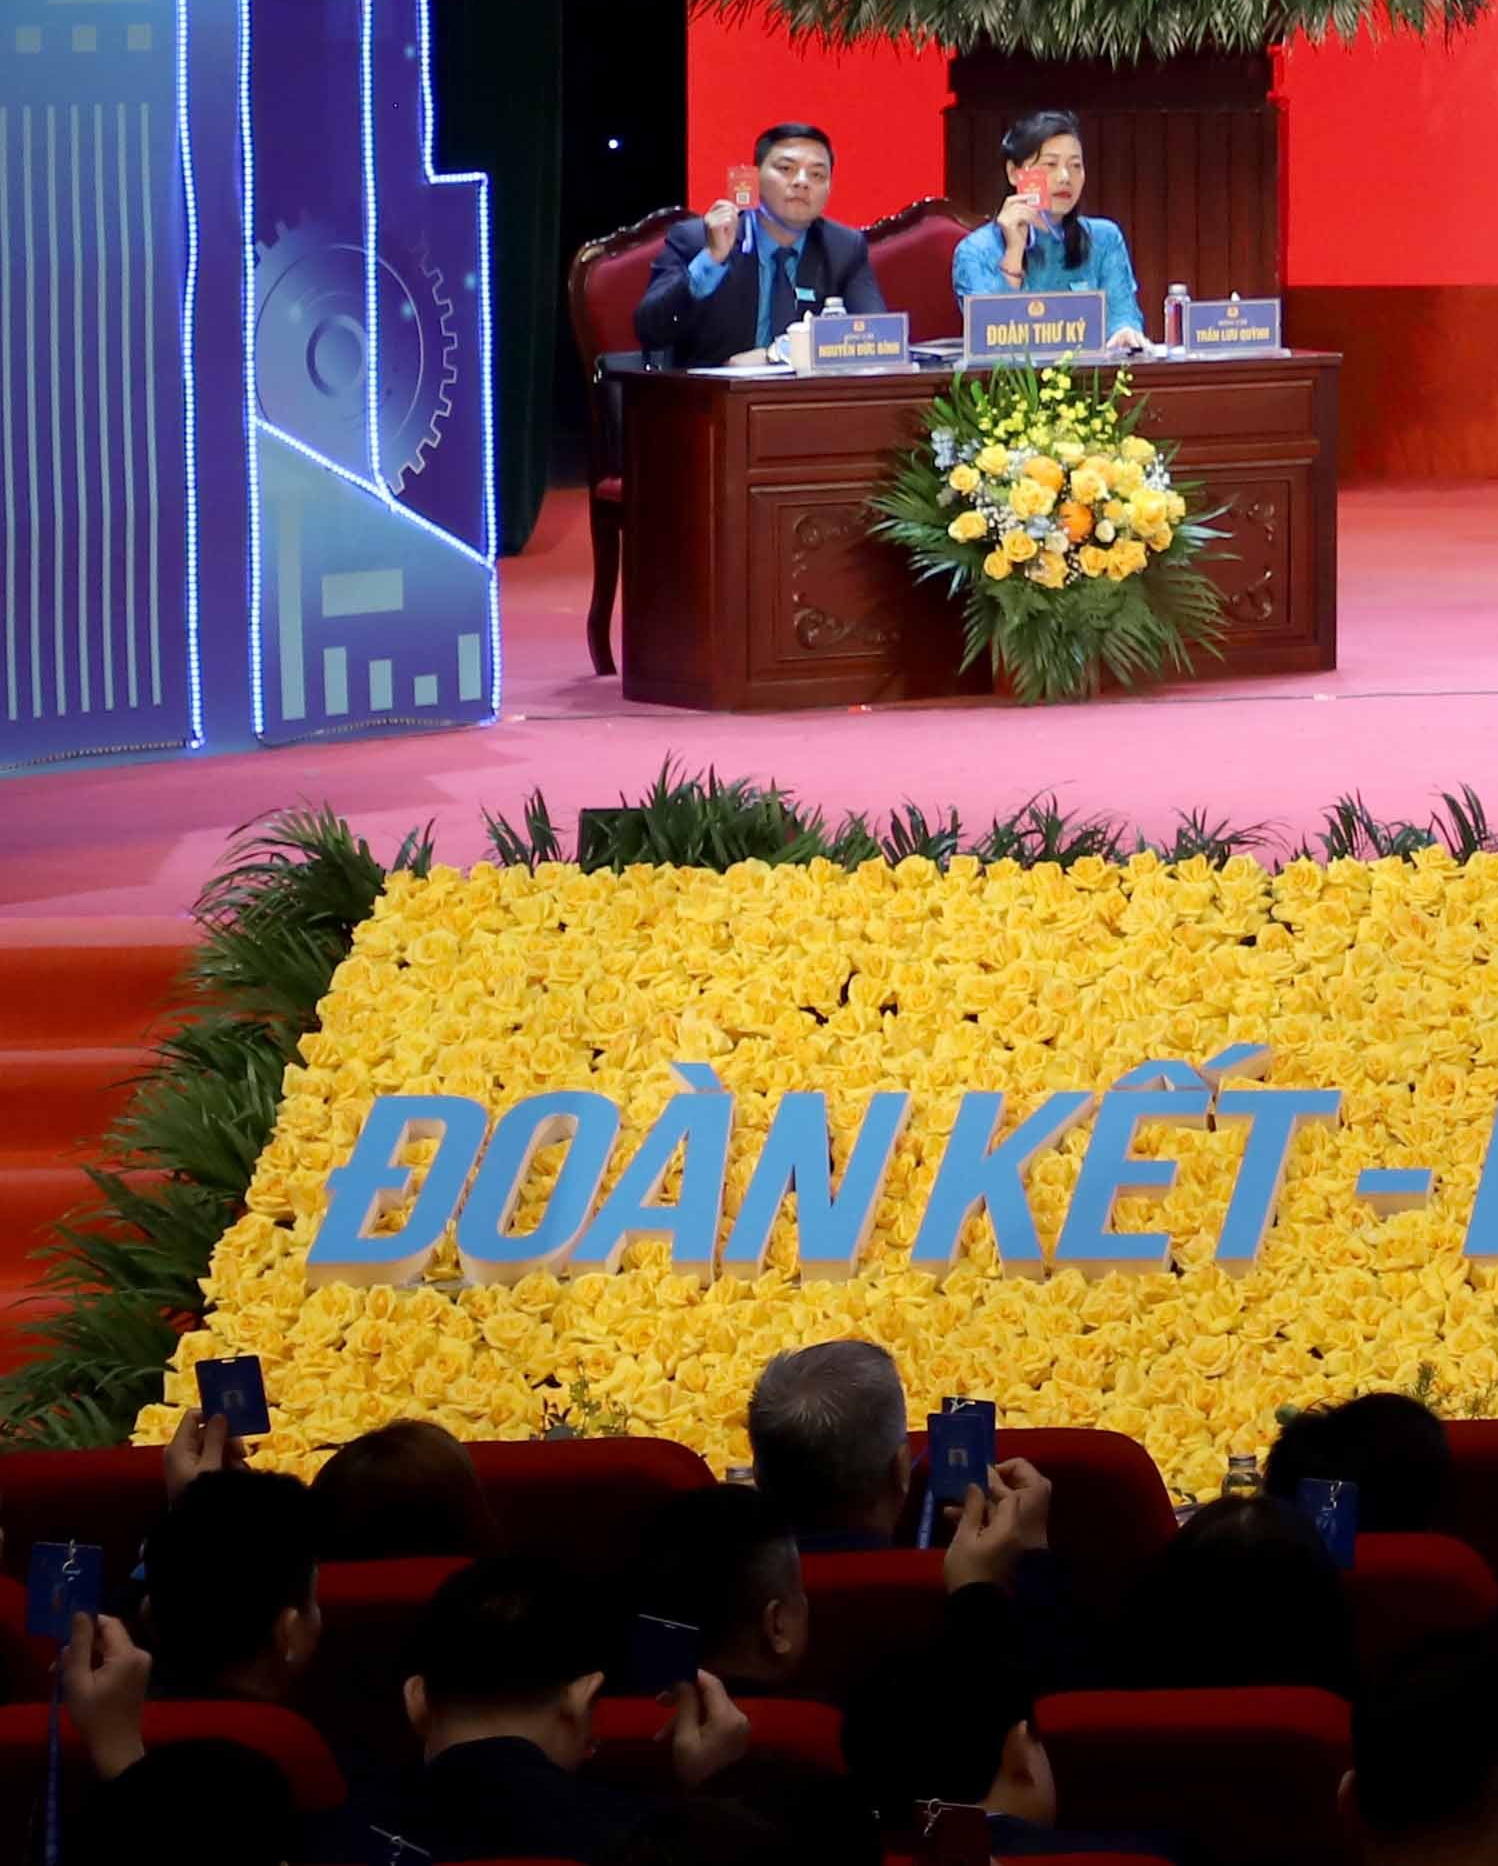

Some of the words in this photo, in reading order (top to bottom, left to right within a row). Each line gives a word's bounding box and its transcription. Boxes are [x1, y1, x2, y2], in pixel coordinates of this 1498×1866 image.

[986, 319, 1029, 347] ĐOÀN
[1032, 319, 1064, 345] THƯ
[304, 1060, 910, 1272] ĐOÀN
[908, 1040, 1347, 1270] KẾT
